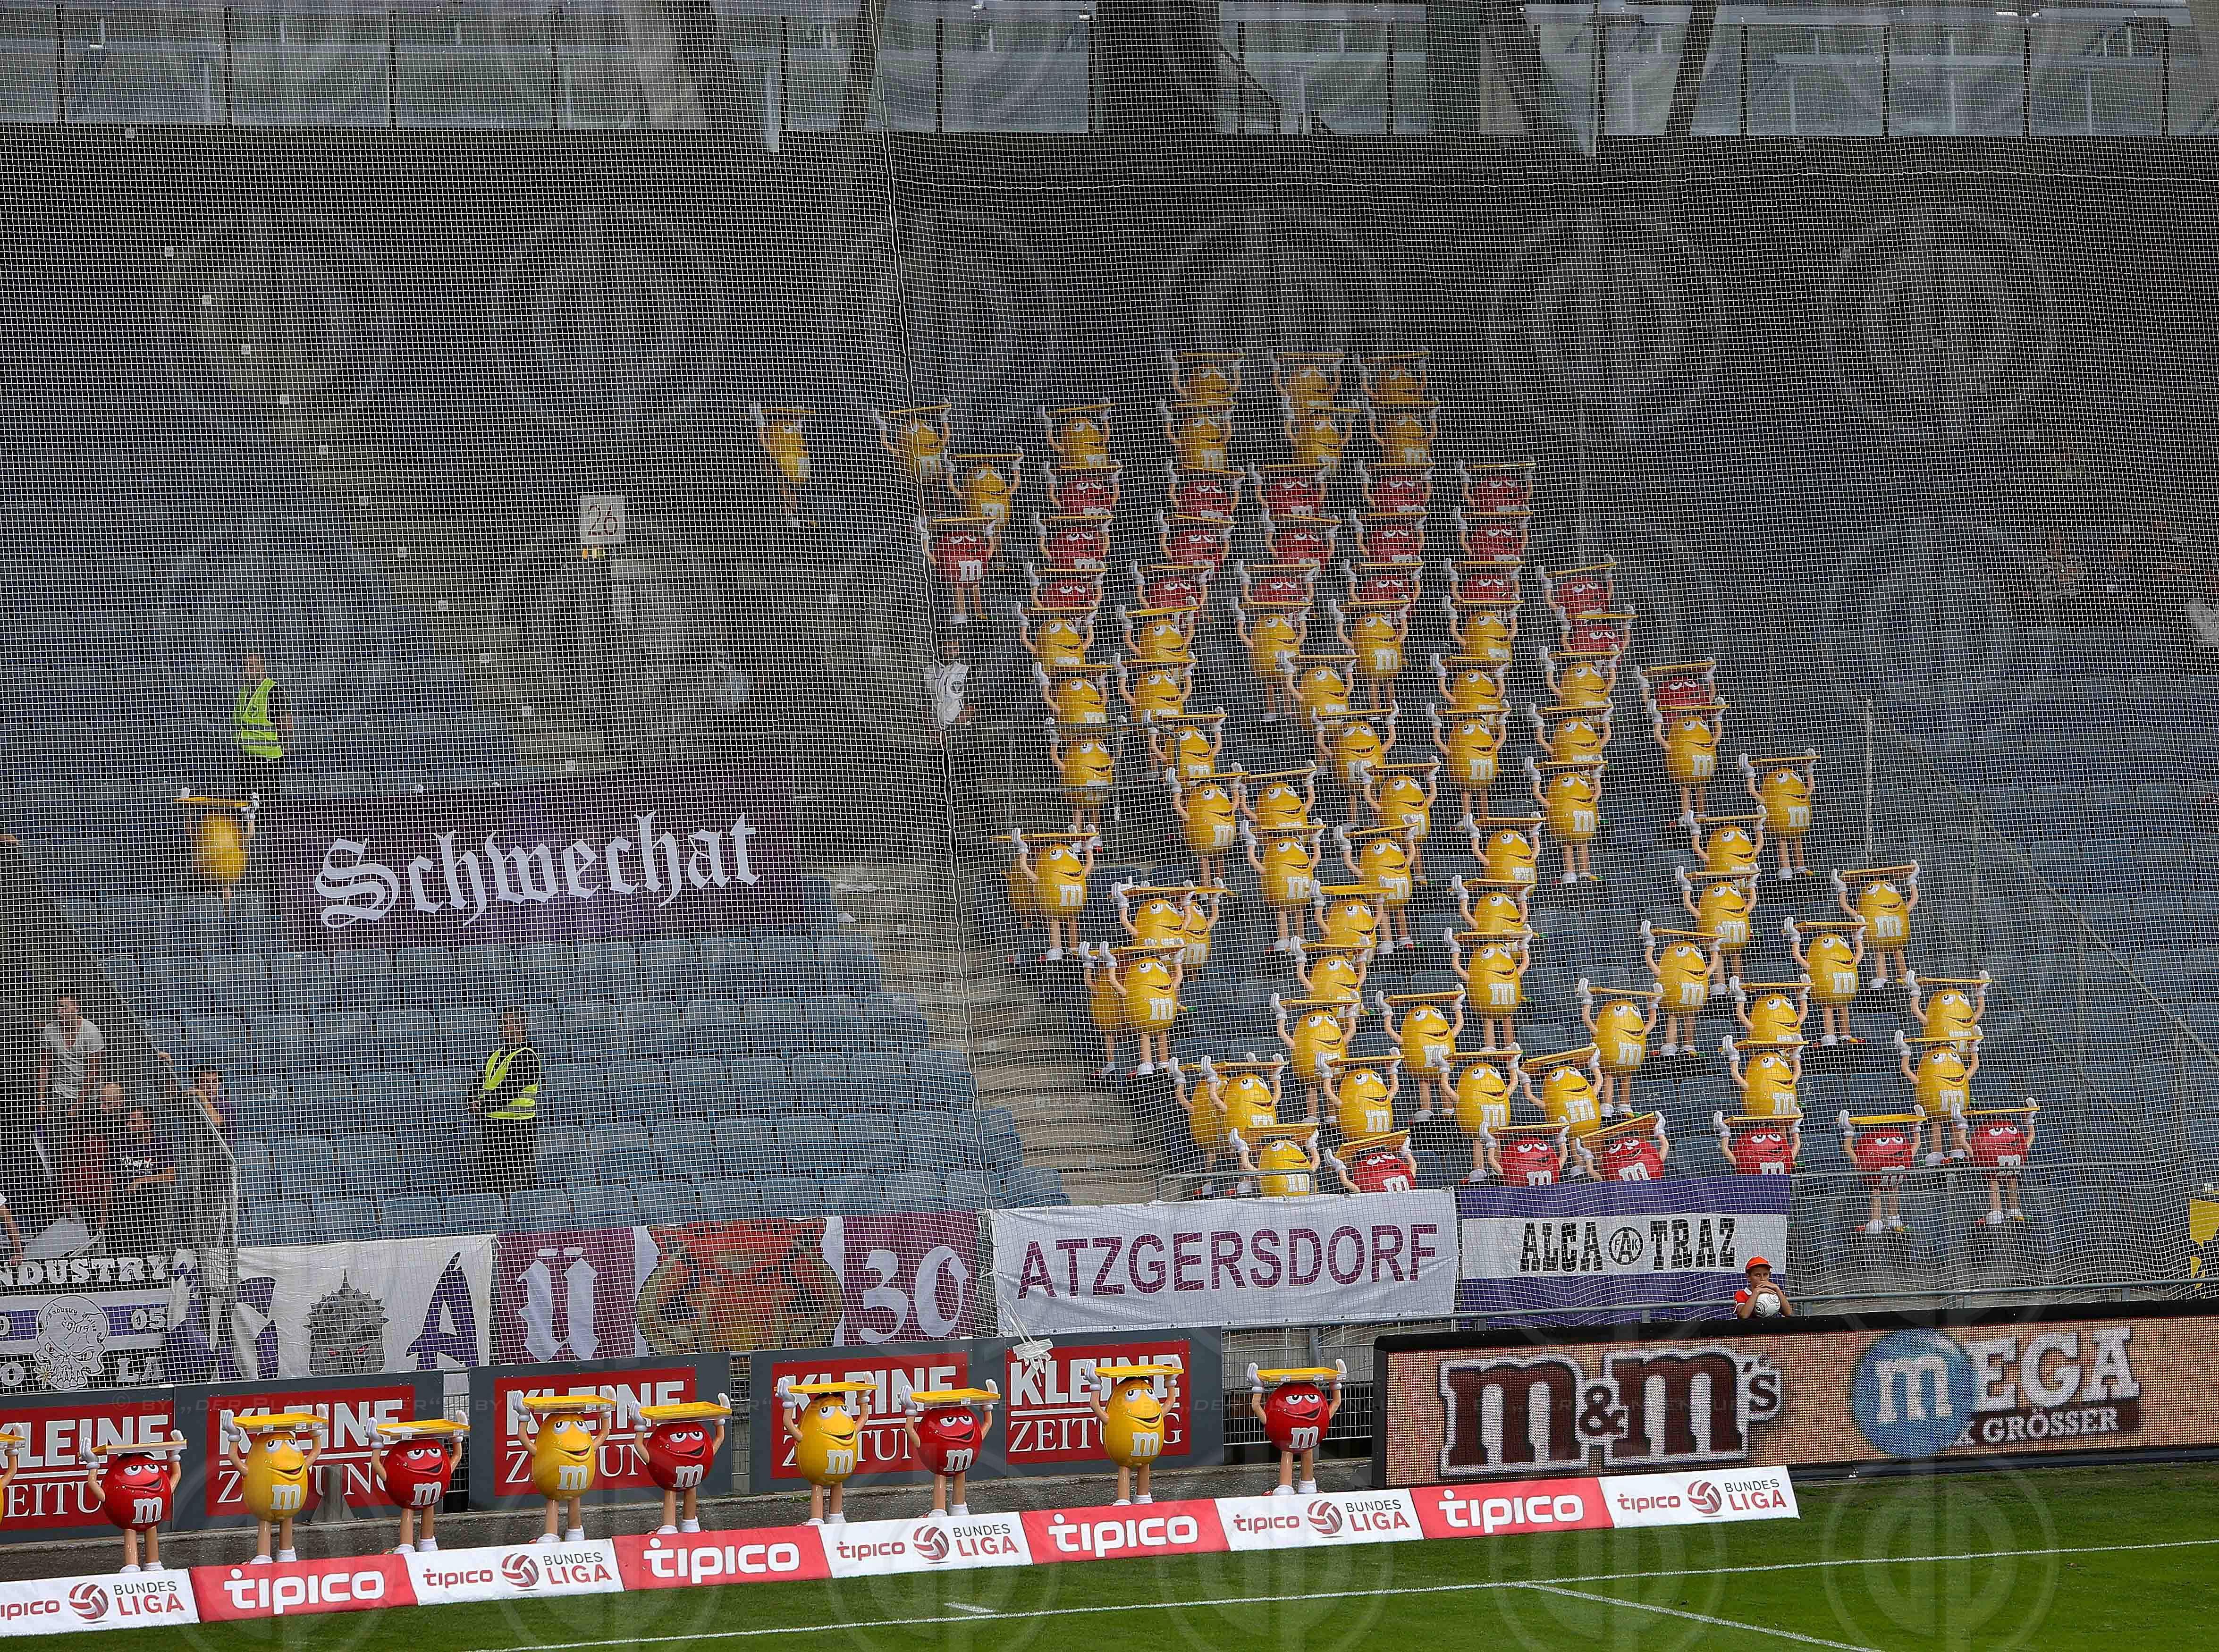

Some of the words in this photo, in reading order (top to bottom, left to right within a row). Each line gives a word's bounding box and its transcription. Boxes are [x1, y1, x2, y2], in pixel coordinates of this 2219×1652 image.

[588, 504, 618, 536] 26
[959, 560, 982, 582] m
[315, 811, 758, 928] Schwechat
[1060, 885, 1083, 906] m
[1875, 915, 1903, 937] m
[1488, 984, 1516, 1005] m
[1680, 982, 1705, 1006] m
[1832, 971, 1857, 994] m
[1150, 997, 1173, 1020] m
[1616, 1042, 1642, 1066] m
[1365, 1110, 1390, 1132] m
[1563, 1099, 1595, 1123] m
[1519, 1221, 1603, 1273] ALCA
[1649, 1217, 1737, 1270] TRAZ
[1017, 1224, 1437, 1299] ATZGERSDORF
[860, 1246, 968, 1343] 30
[1010, 1354, 1180, 1407] KLEE
[1289, 1425, 1319, 1449] m
[1983, 1407, 2119, 1444] GRÖSSER
[1131, 1431, 1160, 1457] m
[826, 1449, 854, 1475] m
[945, 1448, 974, 1472] m
[557, 1465, 589, 1491] m
[672, 1464, 704, 1488] m
[1724, 1478, 1780, 1493] BUNDES
[270, 1484, 301, 1510] m
[411, 1481, 443, 1506] m
[1618, 1492, 1681, 1513] tipico
[1729, 1489, 1787, 1511] LIGA
[132, 1497, 162, 1524] m
[1346, 1499, 1401, 1513] BUNDES
[1438, 1489, 1584, 1533] tipico
[953, 1523, 1011, 1539] BUNDES
[1233, 1513, 1299, 1534] tipico
[1350, 1511, 1410, 1532] LIGA
[957, 1535, 1019, 1557] LIGA
[1048, 1513, 1198, 1558] tipico
[543, 1551, 603, 1567] BUNDES
[643, 1537, 800, 1584] tipico
[837, 1541, 905, 1561] tipico
[423, 1568, 493, 1589] tipico
[547, 1564, 612, 1585] LIGA
[113, 1580, 177, 1596] BUNDES
[224, 1568, 385, 1615] tipico
[119, 1593, 186, 1617] LIGA
